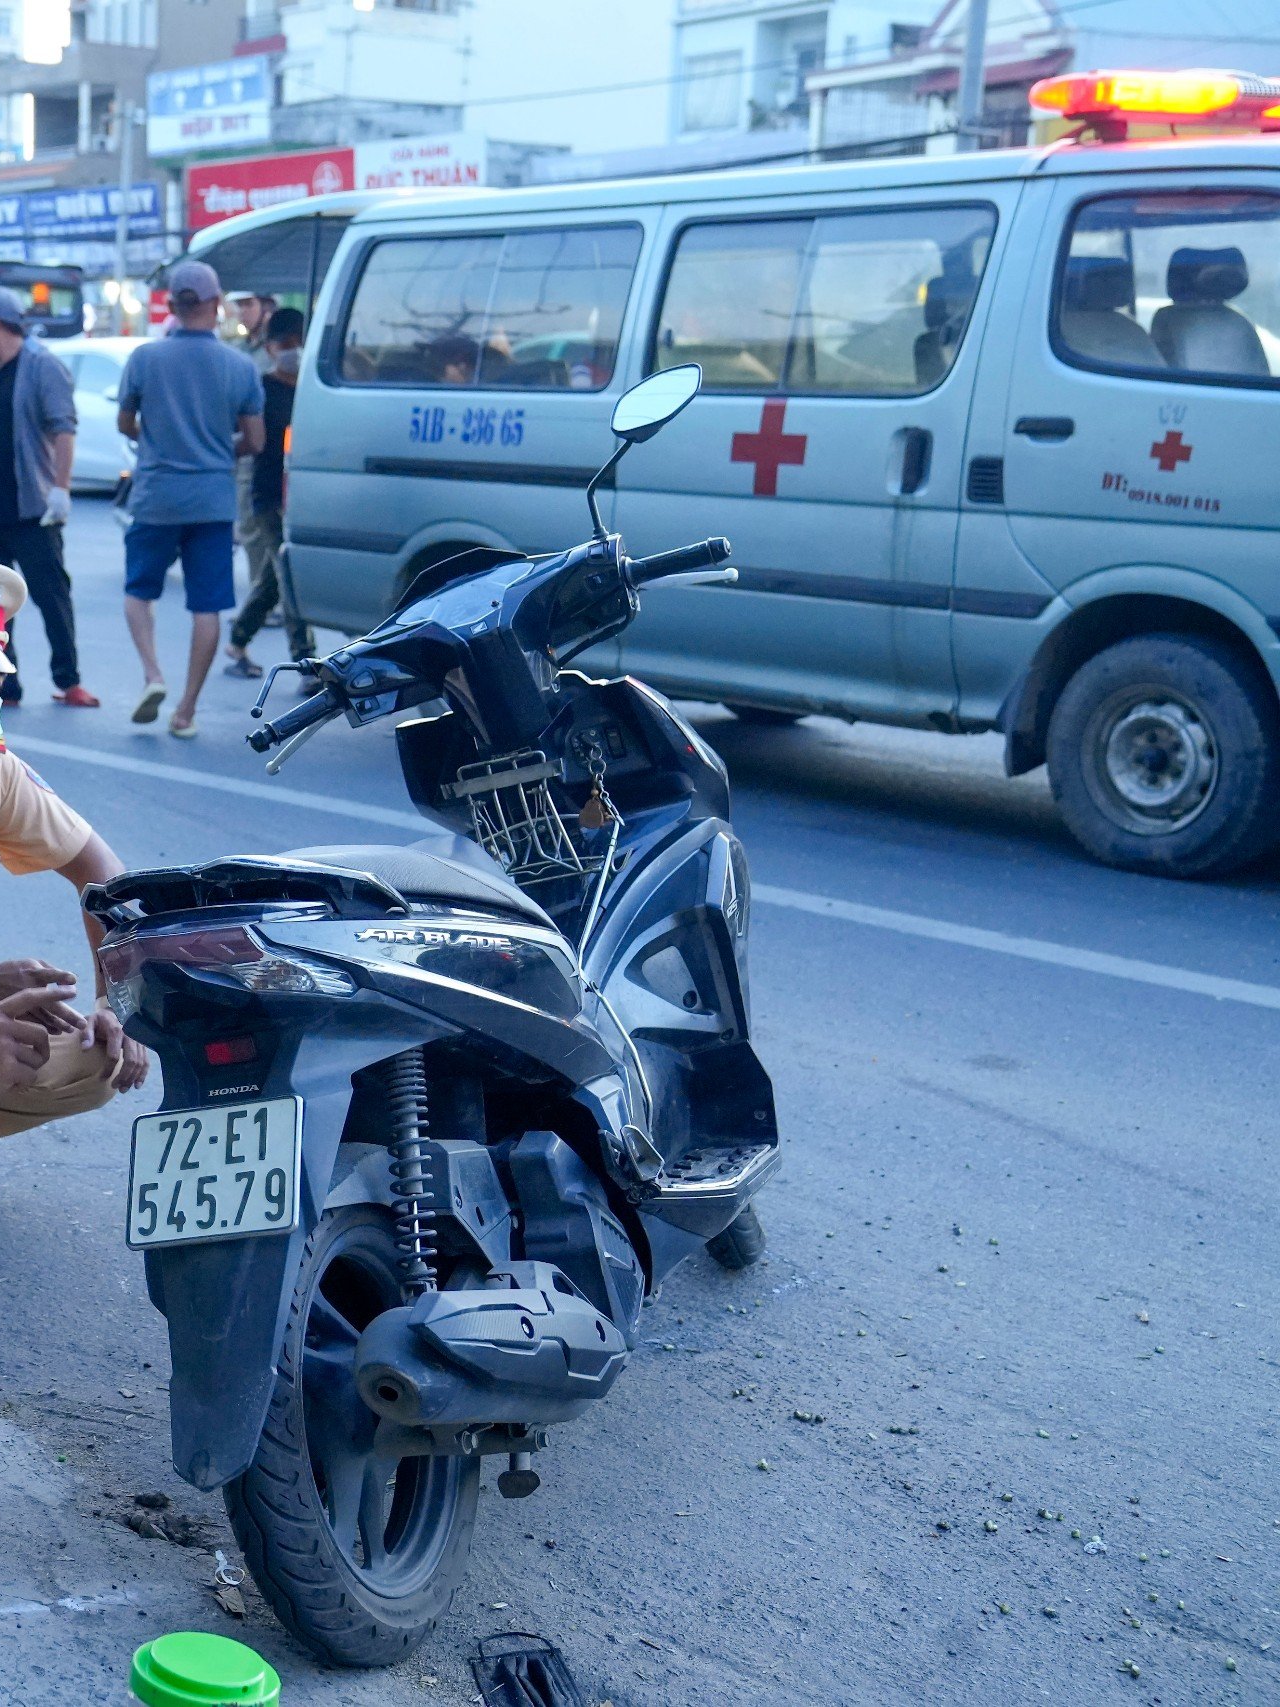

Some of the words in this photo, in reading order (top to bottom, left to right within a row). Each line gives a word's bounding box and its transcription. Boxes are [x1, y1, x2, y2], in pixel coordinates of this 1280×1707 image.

[354, 928, 417, 944] AIR
[421, 931, 514, 951] BLADE
[207, 1083, 260, 1098] HONDA
[156, 1107, 269, 1175] 72-E1
[137, 1167, 287, 1237] 545.79
